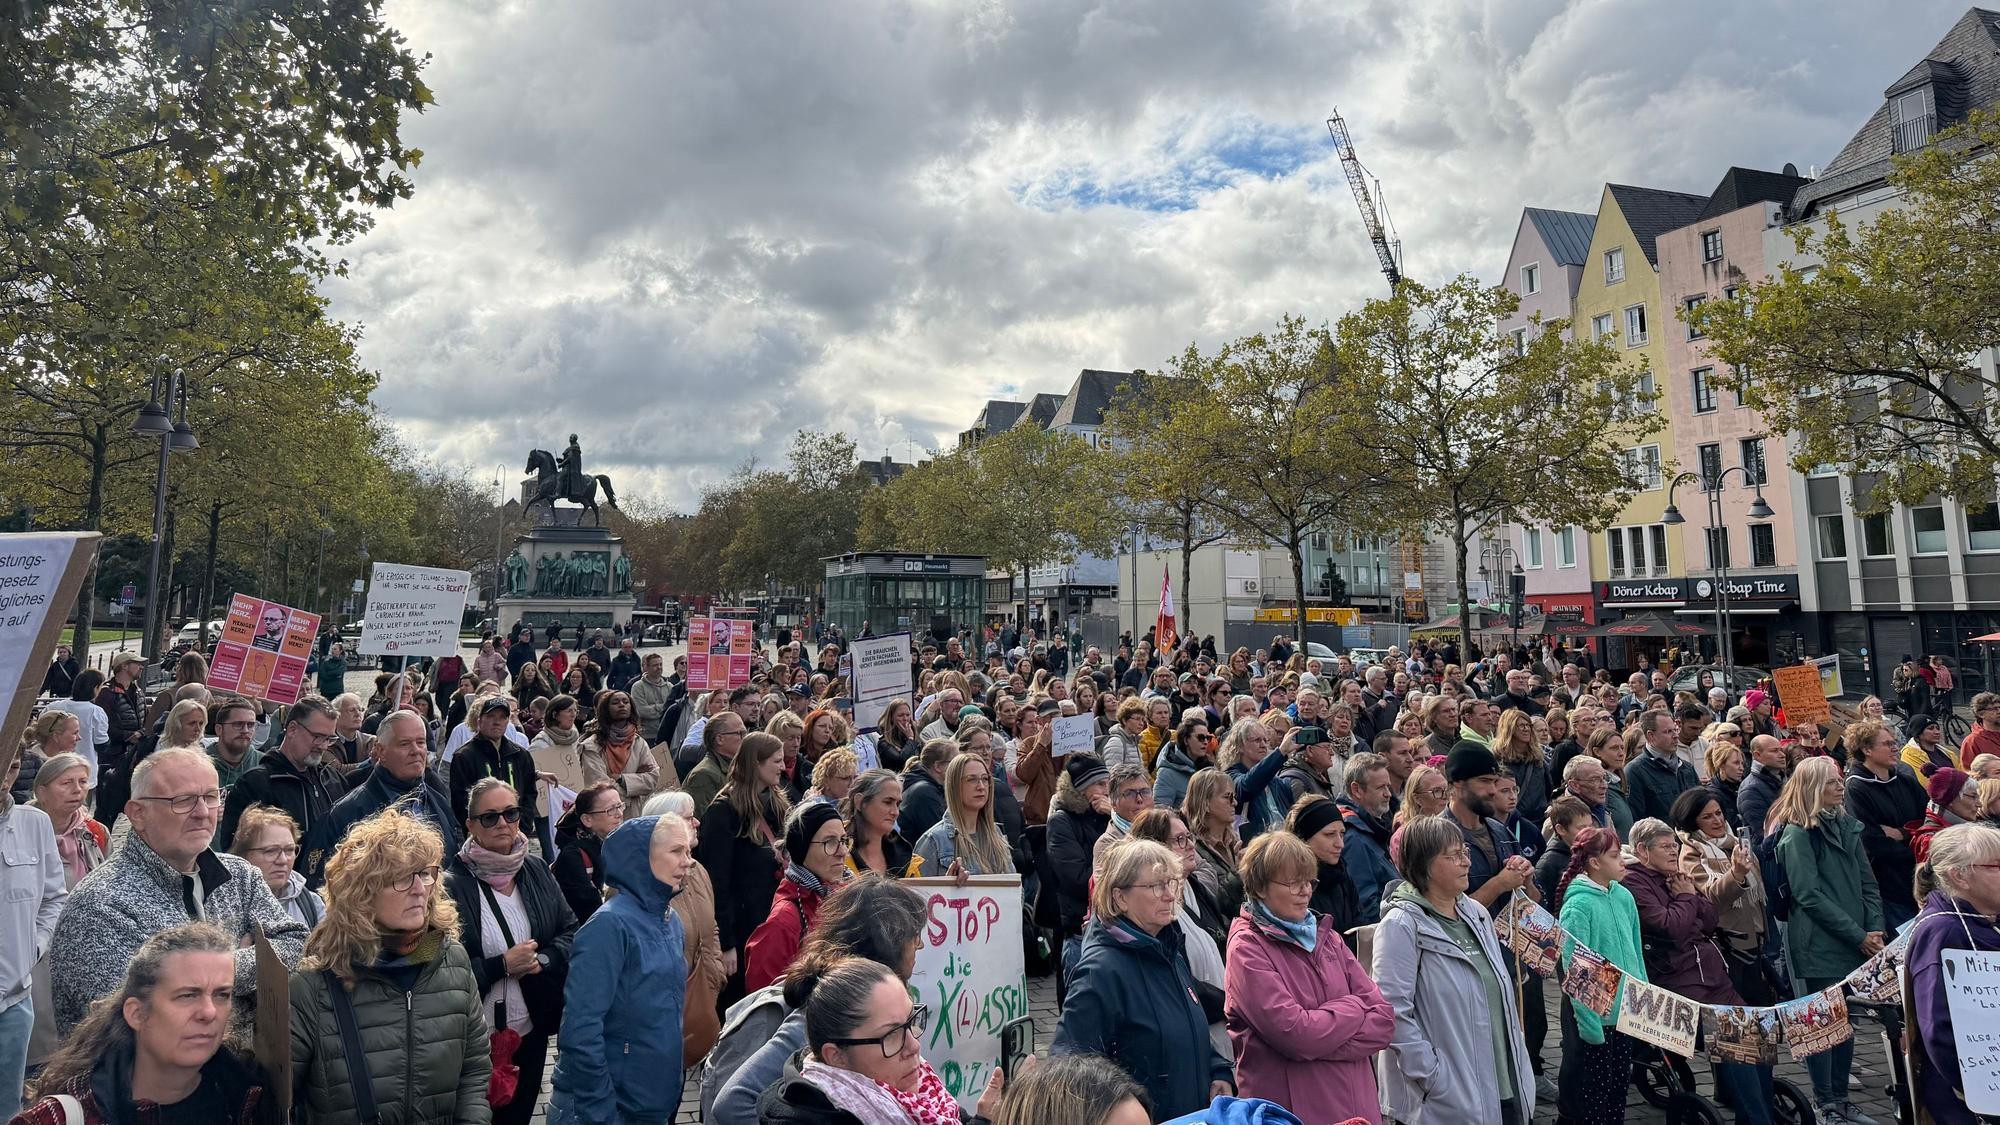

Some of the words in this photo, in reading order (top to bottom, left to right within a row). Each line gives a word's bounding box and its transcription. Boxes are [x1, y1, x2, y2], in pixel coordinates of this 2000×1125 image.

[1613, 586, 1644, 597] Döner
[1644, 583, 1679, 599] Kebap
[1754, 580, 1785, 592] Time
[7, 612, 31, 627] auf
[927, 893, 1000, 947] STOP
[944, 951, 971, 978] die
[1965, 956, 1990, 972] Mit
[1963, 986, 1998, 996] MOTT
[1628, 983, 1695, 1035] WIR
[1628, 1020, 1641, 1029] WIR
[1642, 1026, 1660, 1038] LEBEN
[1661, 1033, 1670, 1041] DIE
[1671, 1037, 1689, 1048] PFLEGE
